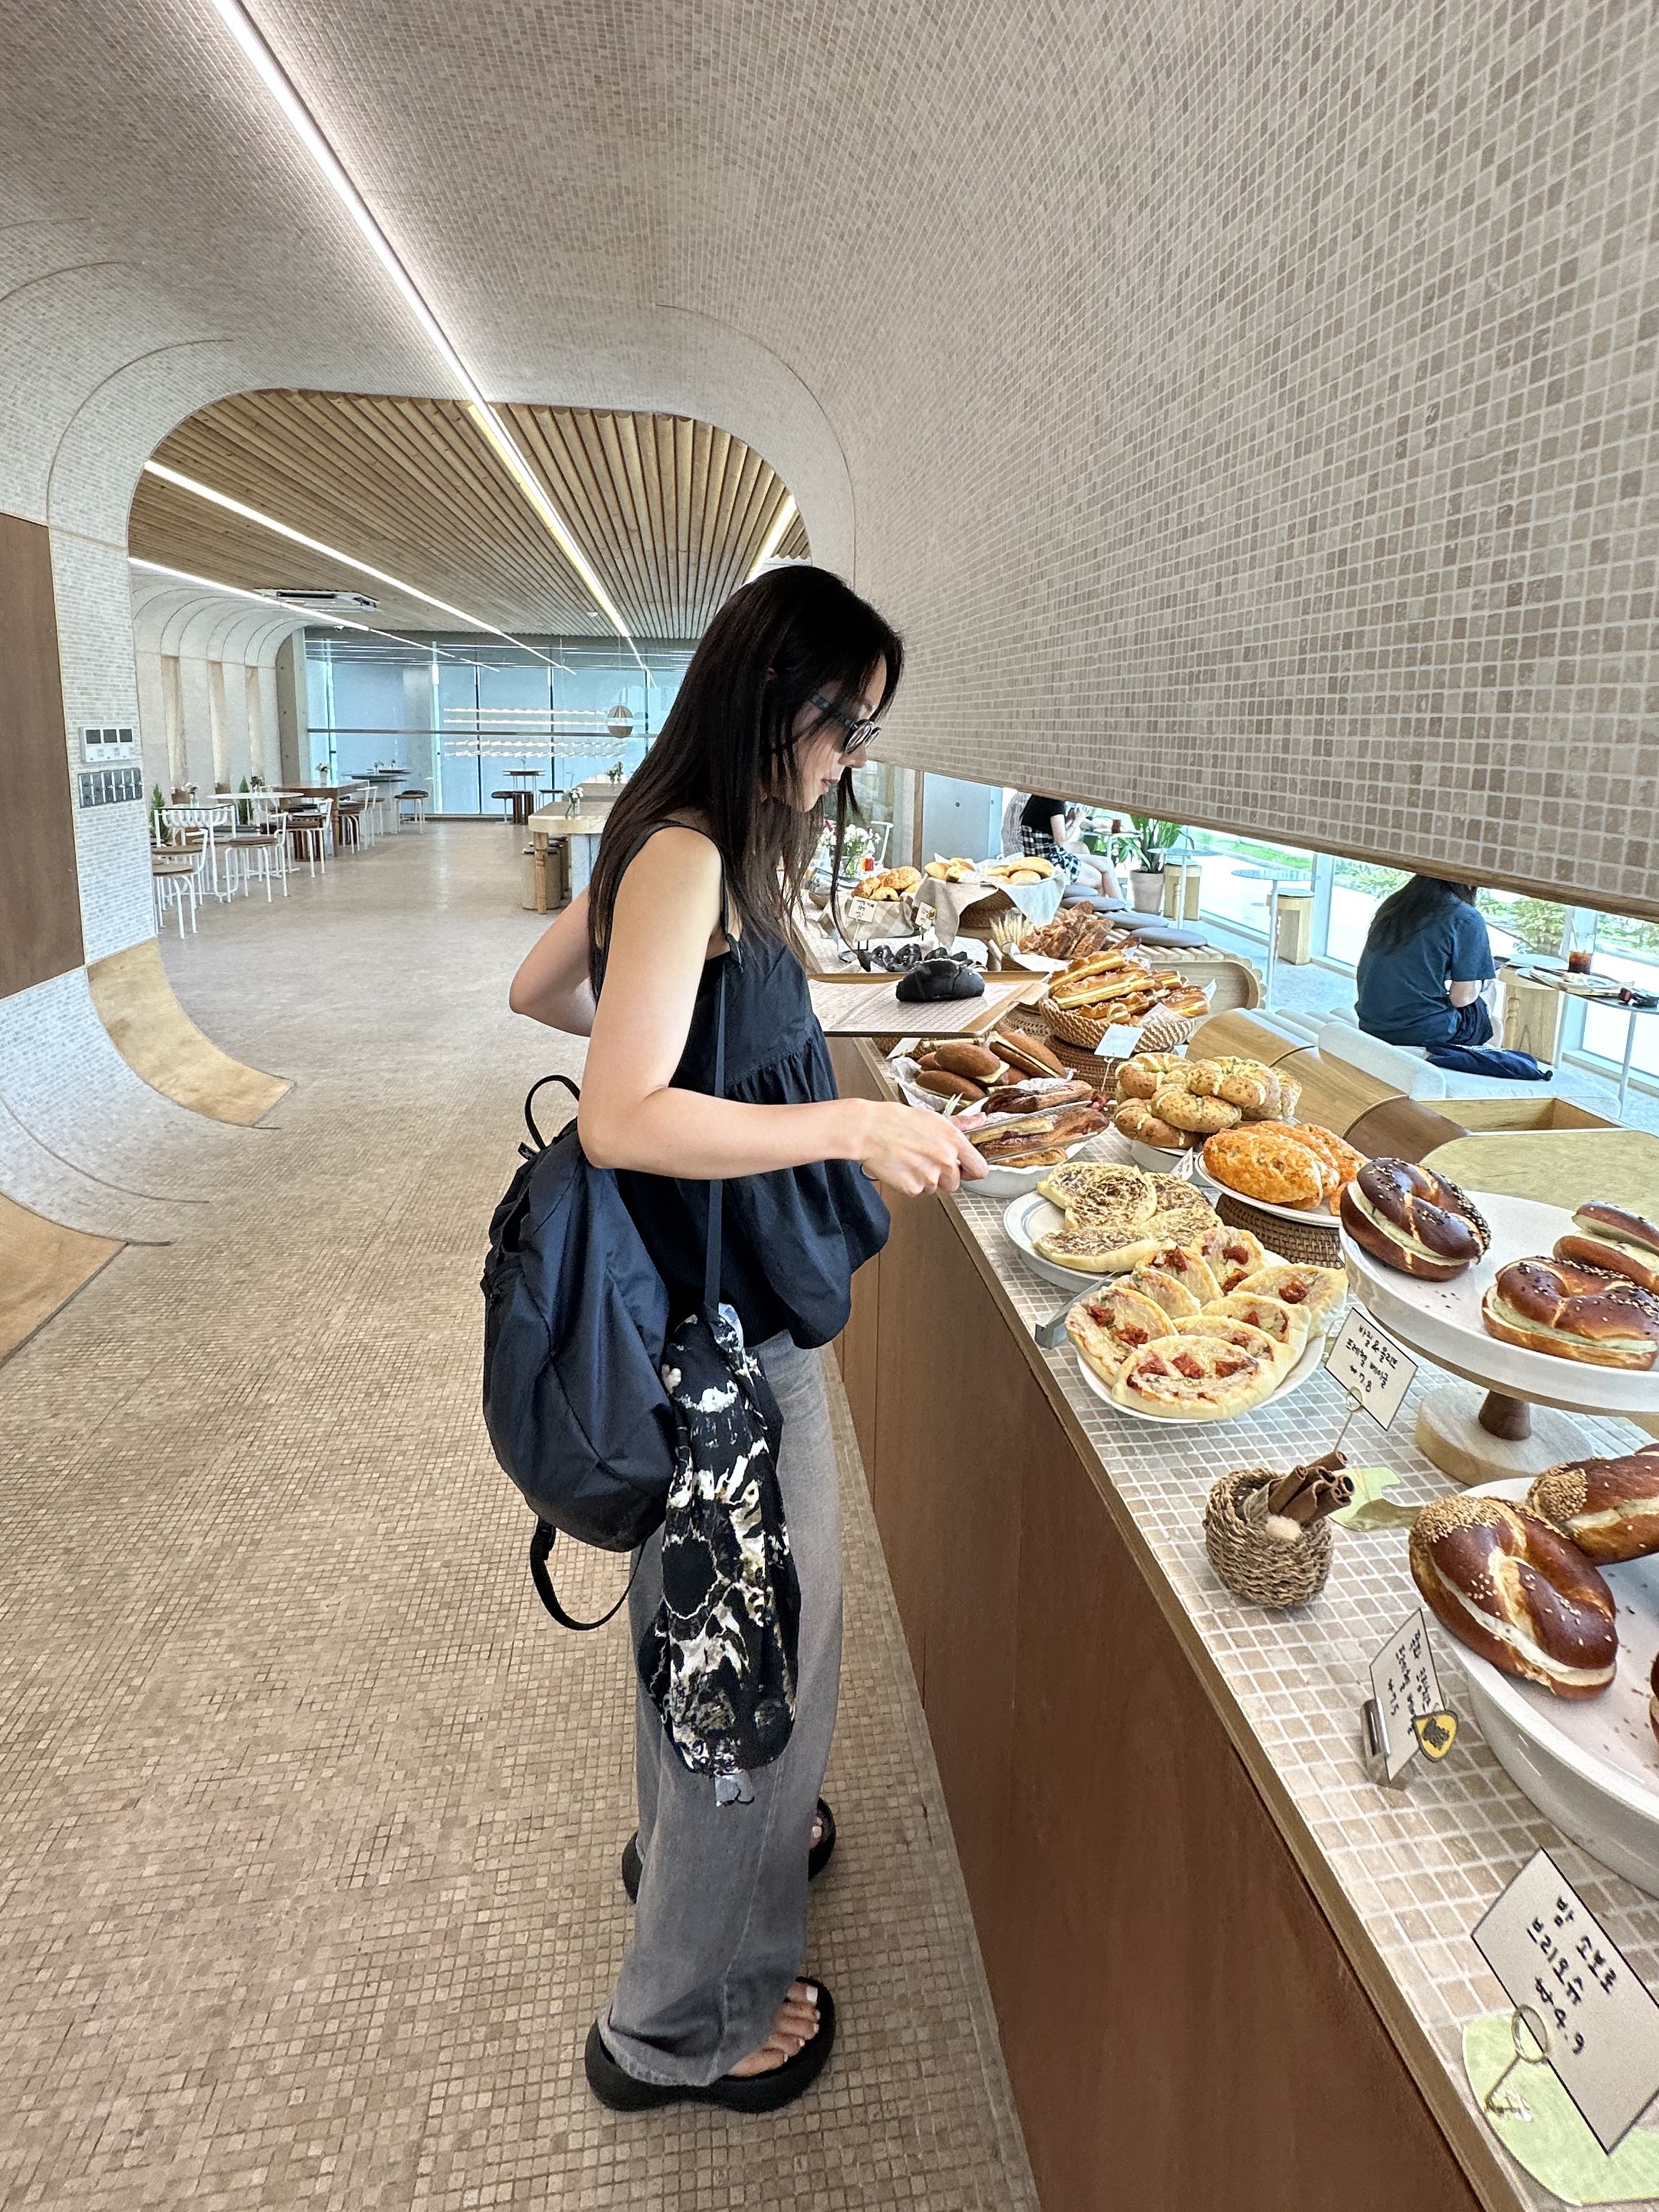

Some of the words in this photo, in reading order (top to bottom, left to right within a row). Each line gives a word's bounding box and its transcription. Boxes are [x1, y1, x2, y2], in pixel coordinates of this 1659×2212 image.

[1345, 1338, 1368, 1368] 프레첼
[1370, 1362, 1388, 1389] 베이글
[1395, 1644, 1410, 1693] 프레첼
[1526, 1917, 1583, 2006] 브리오슈
[1554, 1896, 1574, 1928] 밤
[1575, 1936, 1617, 1994] 소보로
